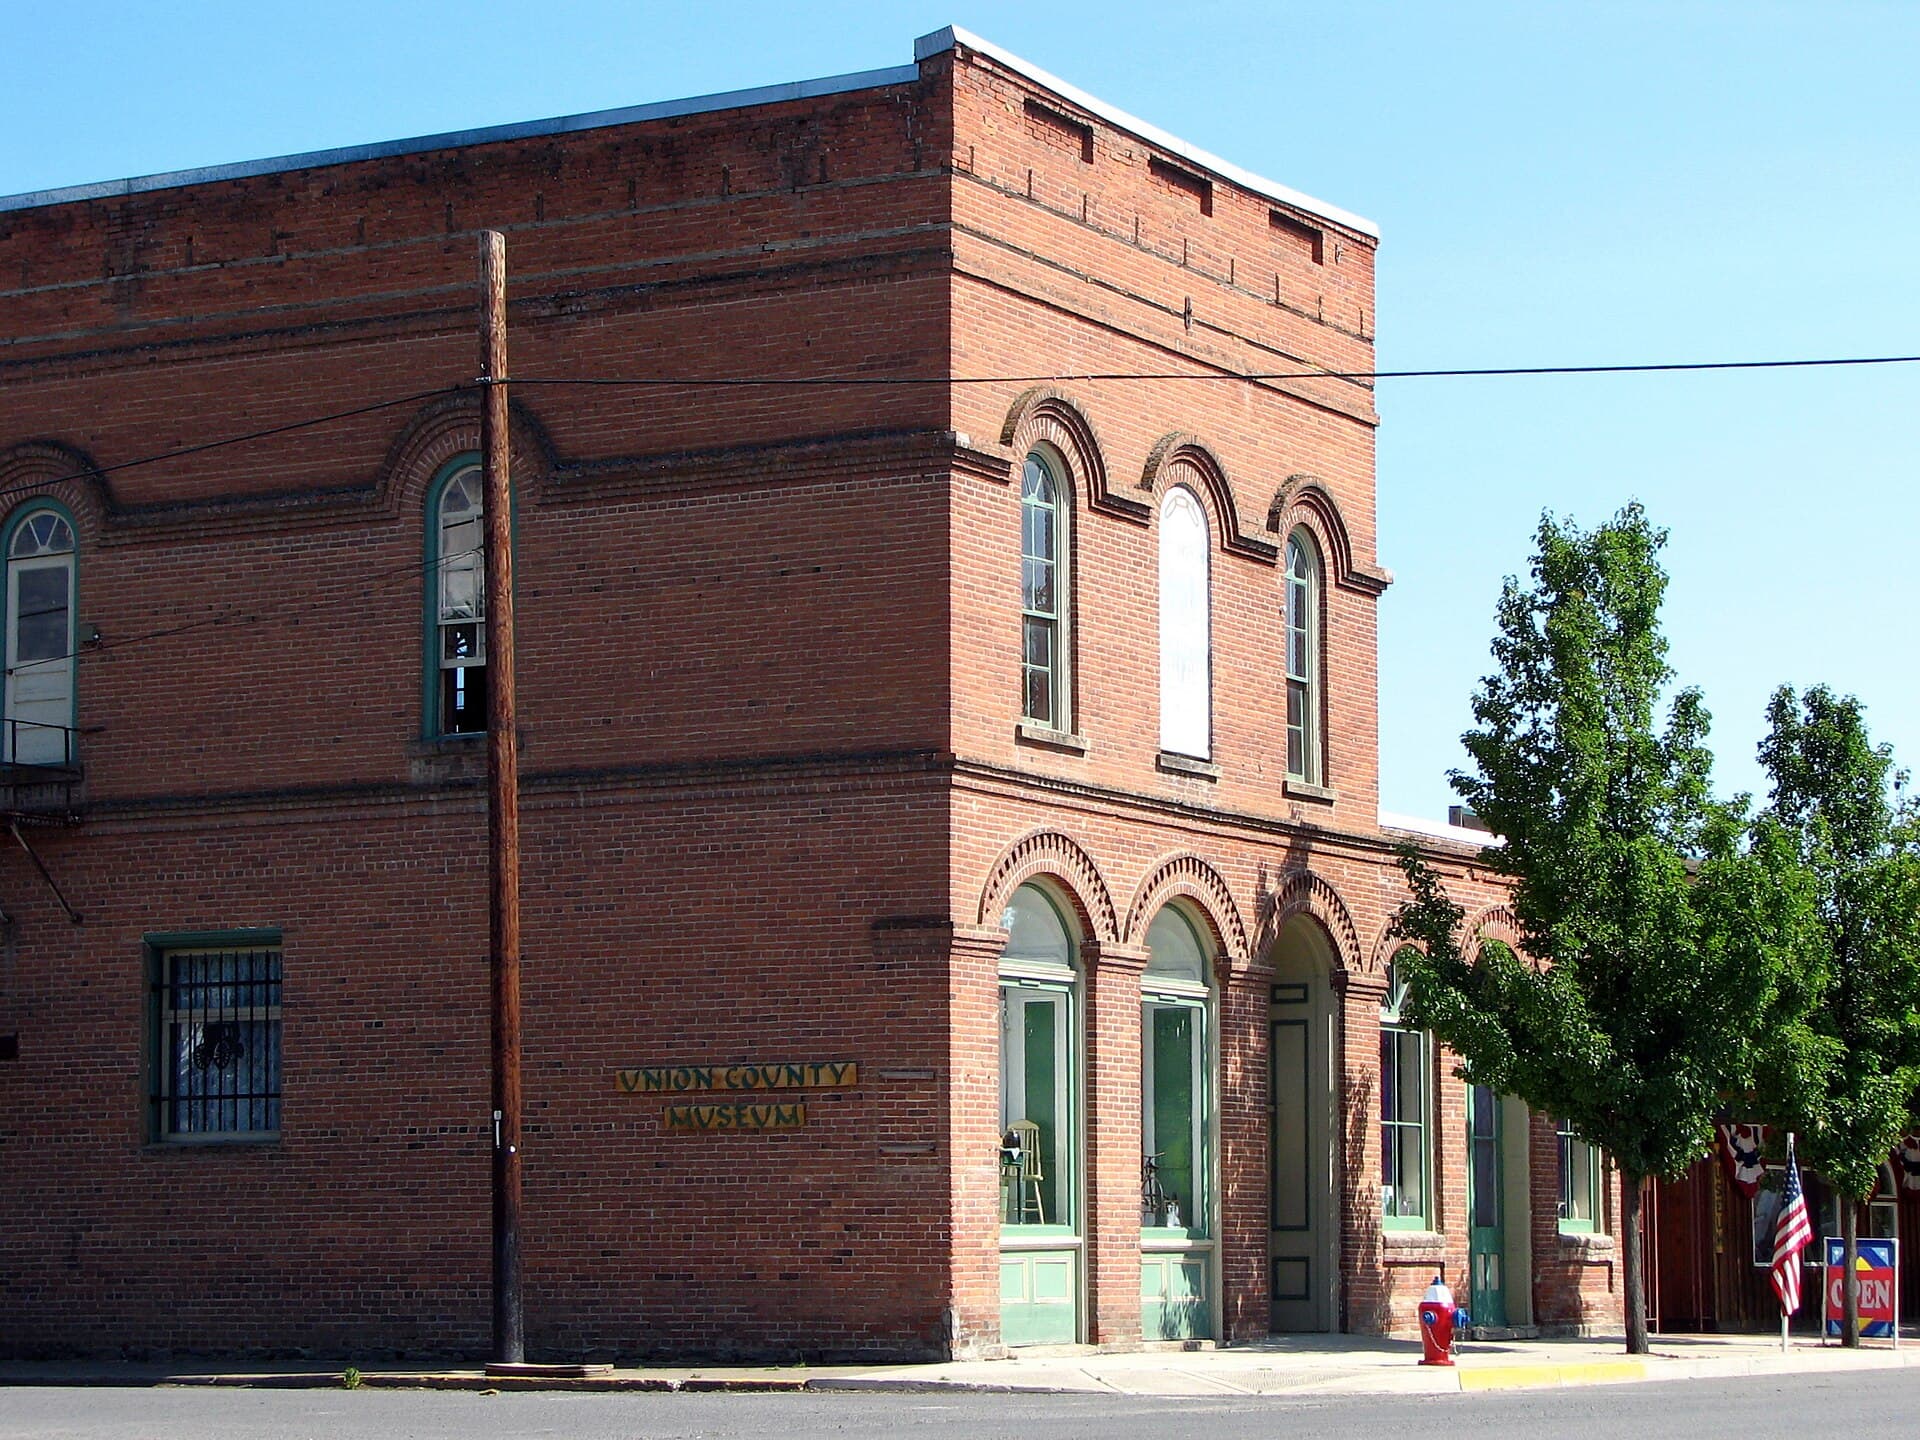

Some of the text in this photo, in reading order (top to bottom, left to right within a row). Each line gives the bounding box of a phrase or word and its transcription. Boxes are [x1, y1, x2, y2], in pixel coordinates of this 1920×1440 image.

[619, 1063, 849, 1091] UNION COUNTY
[669, 1104, 800, 1128] MUSEUM
